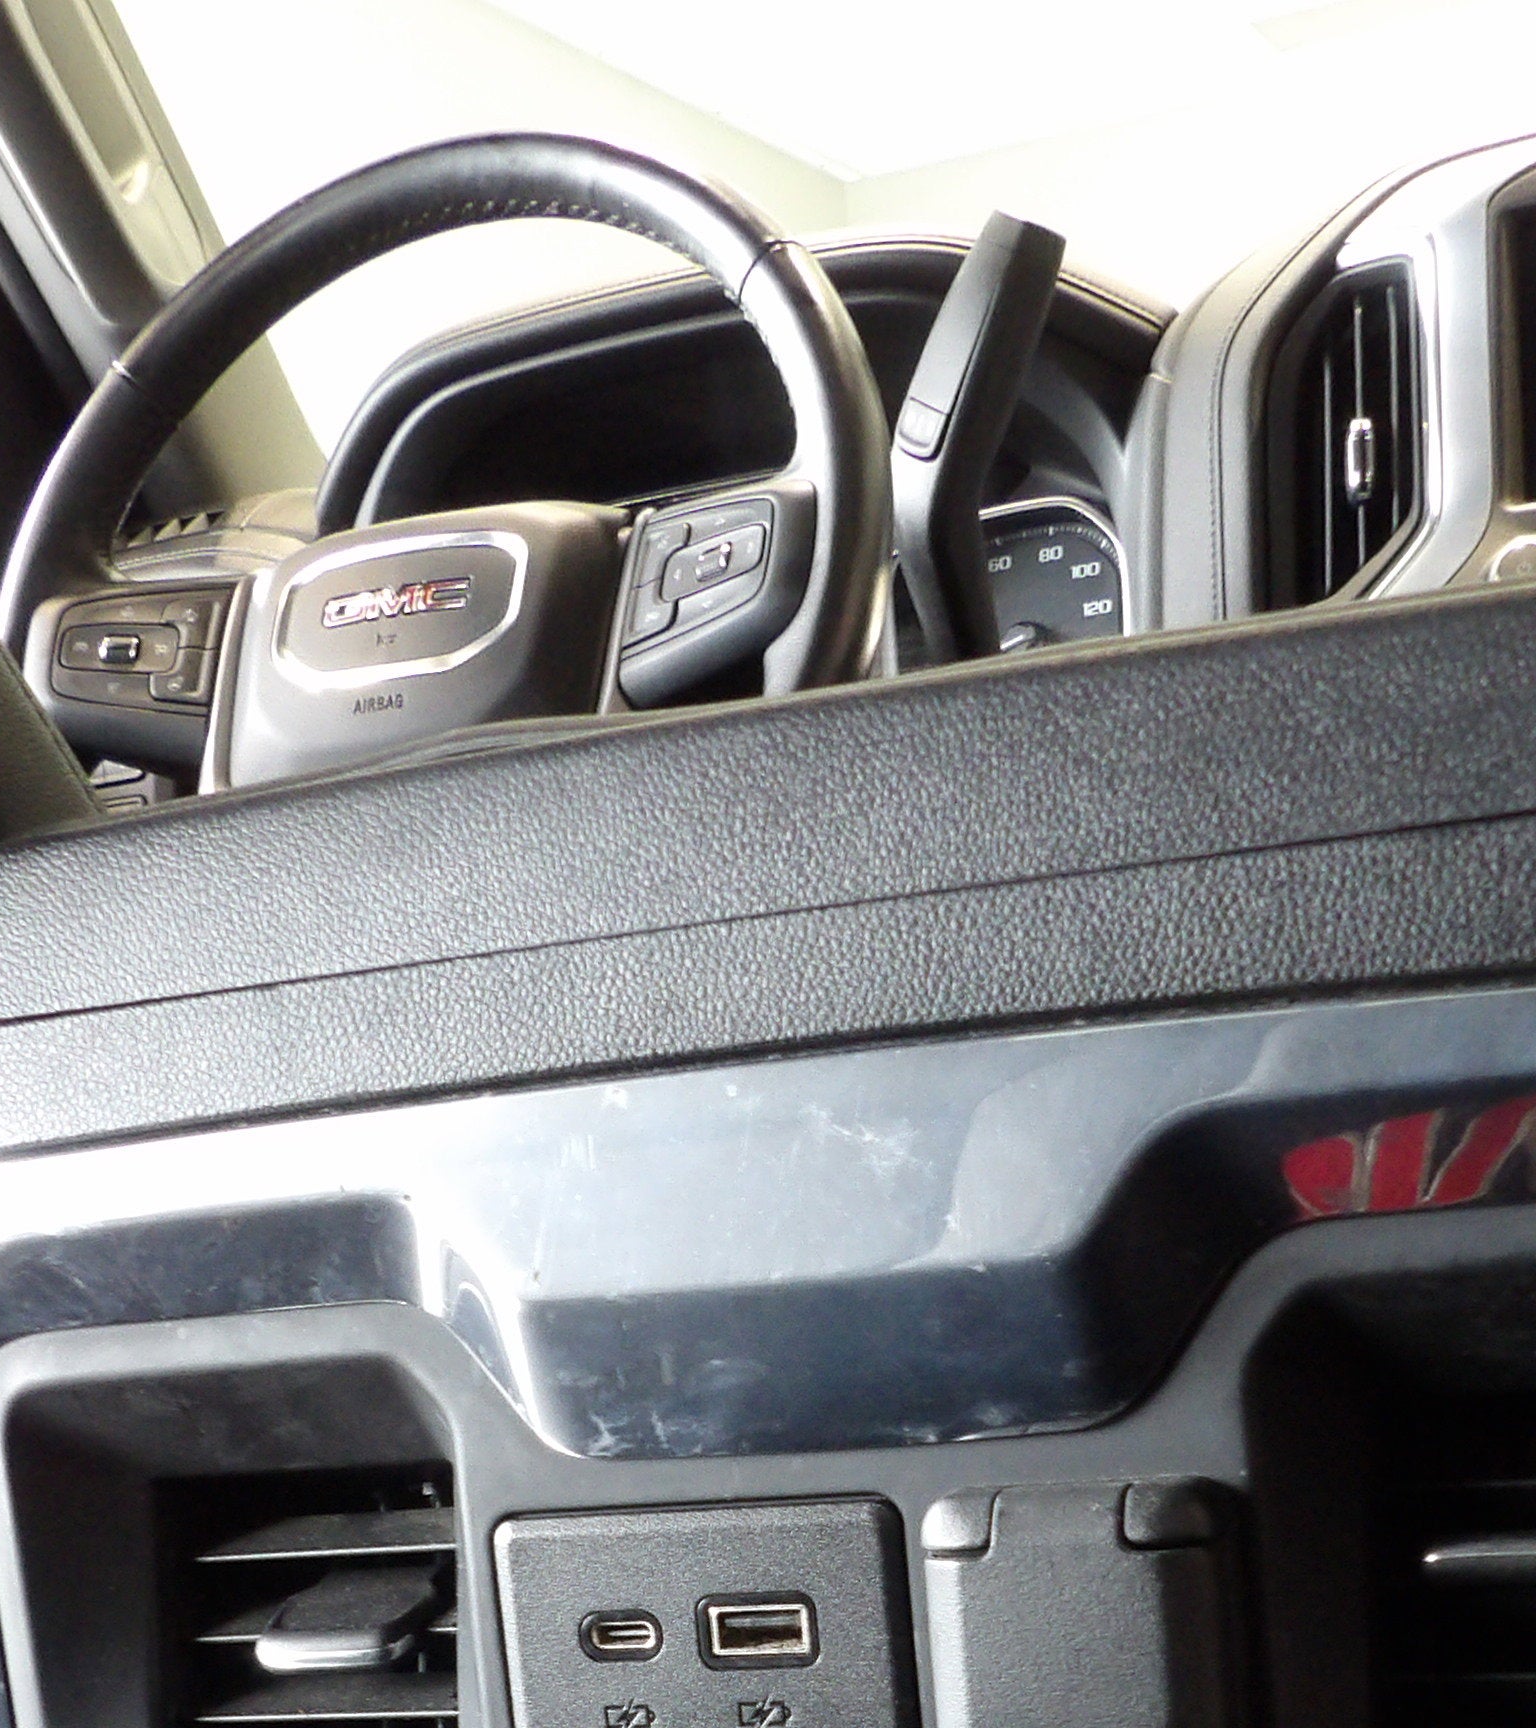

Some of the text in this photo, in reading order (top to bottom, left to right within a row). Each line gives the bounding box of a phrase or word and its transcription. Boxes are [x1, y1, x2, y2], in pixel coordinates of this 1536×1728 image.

[1038, 545, 1063, 563] 80
[988, 555, 1012, 572] 60
[1070, 562, 1100, 579] 100
[322, 576, 472, 629] GMC
[1084, 599, 1112, 616] 120
[353, 694, 404, 714] AIRBAG
